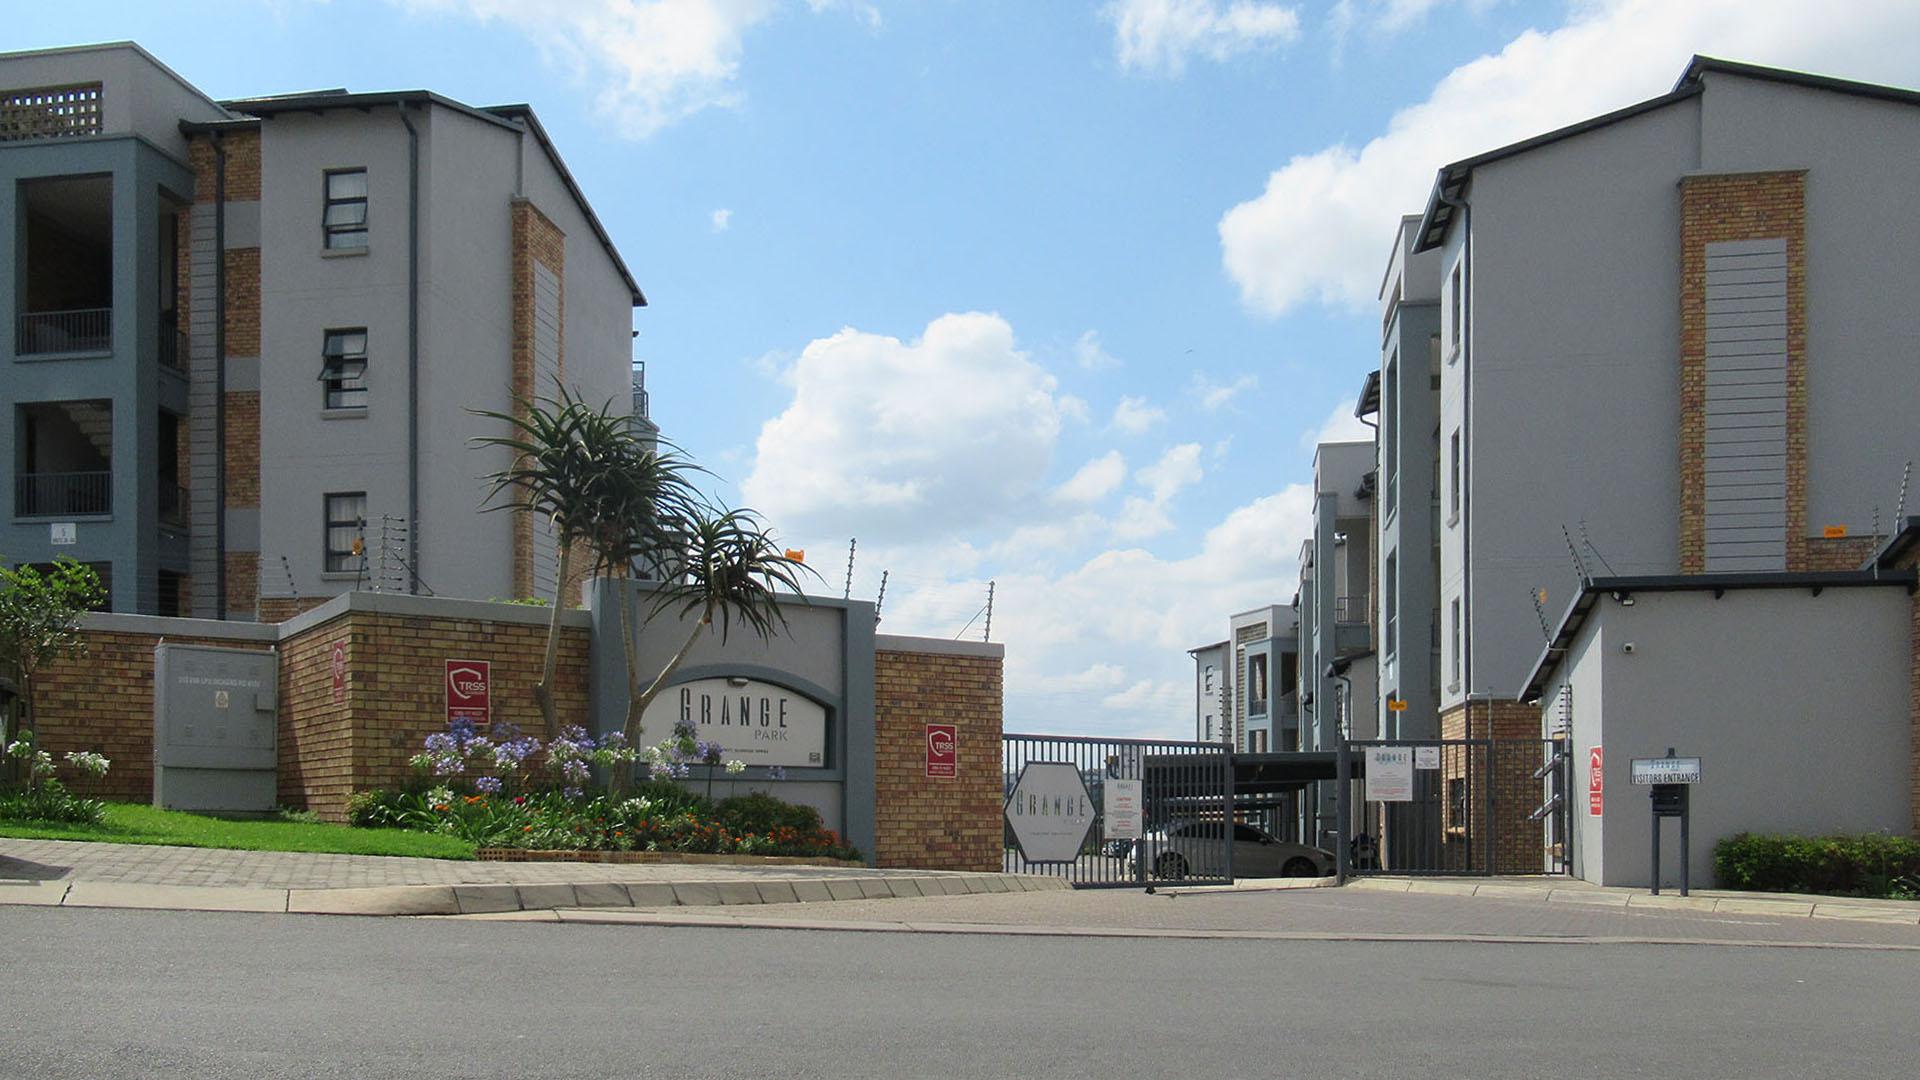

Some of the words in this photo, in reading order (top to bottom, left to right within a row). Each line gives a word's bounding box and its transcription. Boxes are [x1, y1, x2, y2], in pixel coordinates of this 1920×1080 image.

[459, 681, 486, 691] TRSS
[680, 687, 787, 728] GRANGE
[754, 729, 788, 741] PARK
[935, 742, 954, 750] TRSS
[1664, 772, 1699, 783] ENTRANCE
[1016, 789, 1086, 817] GRANGE
